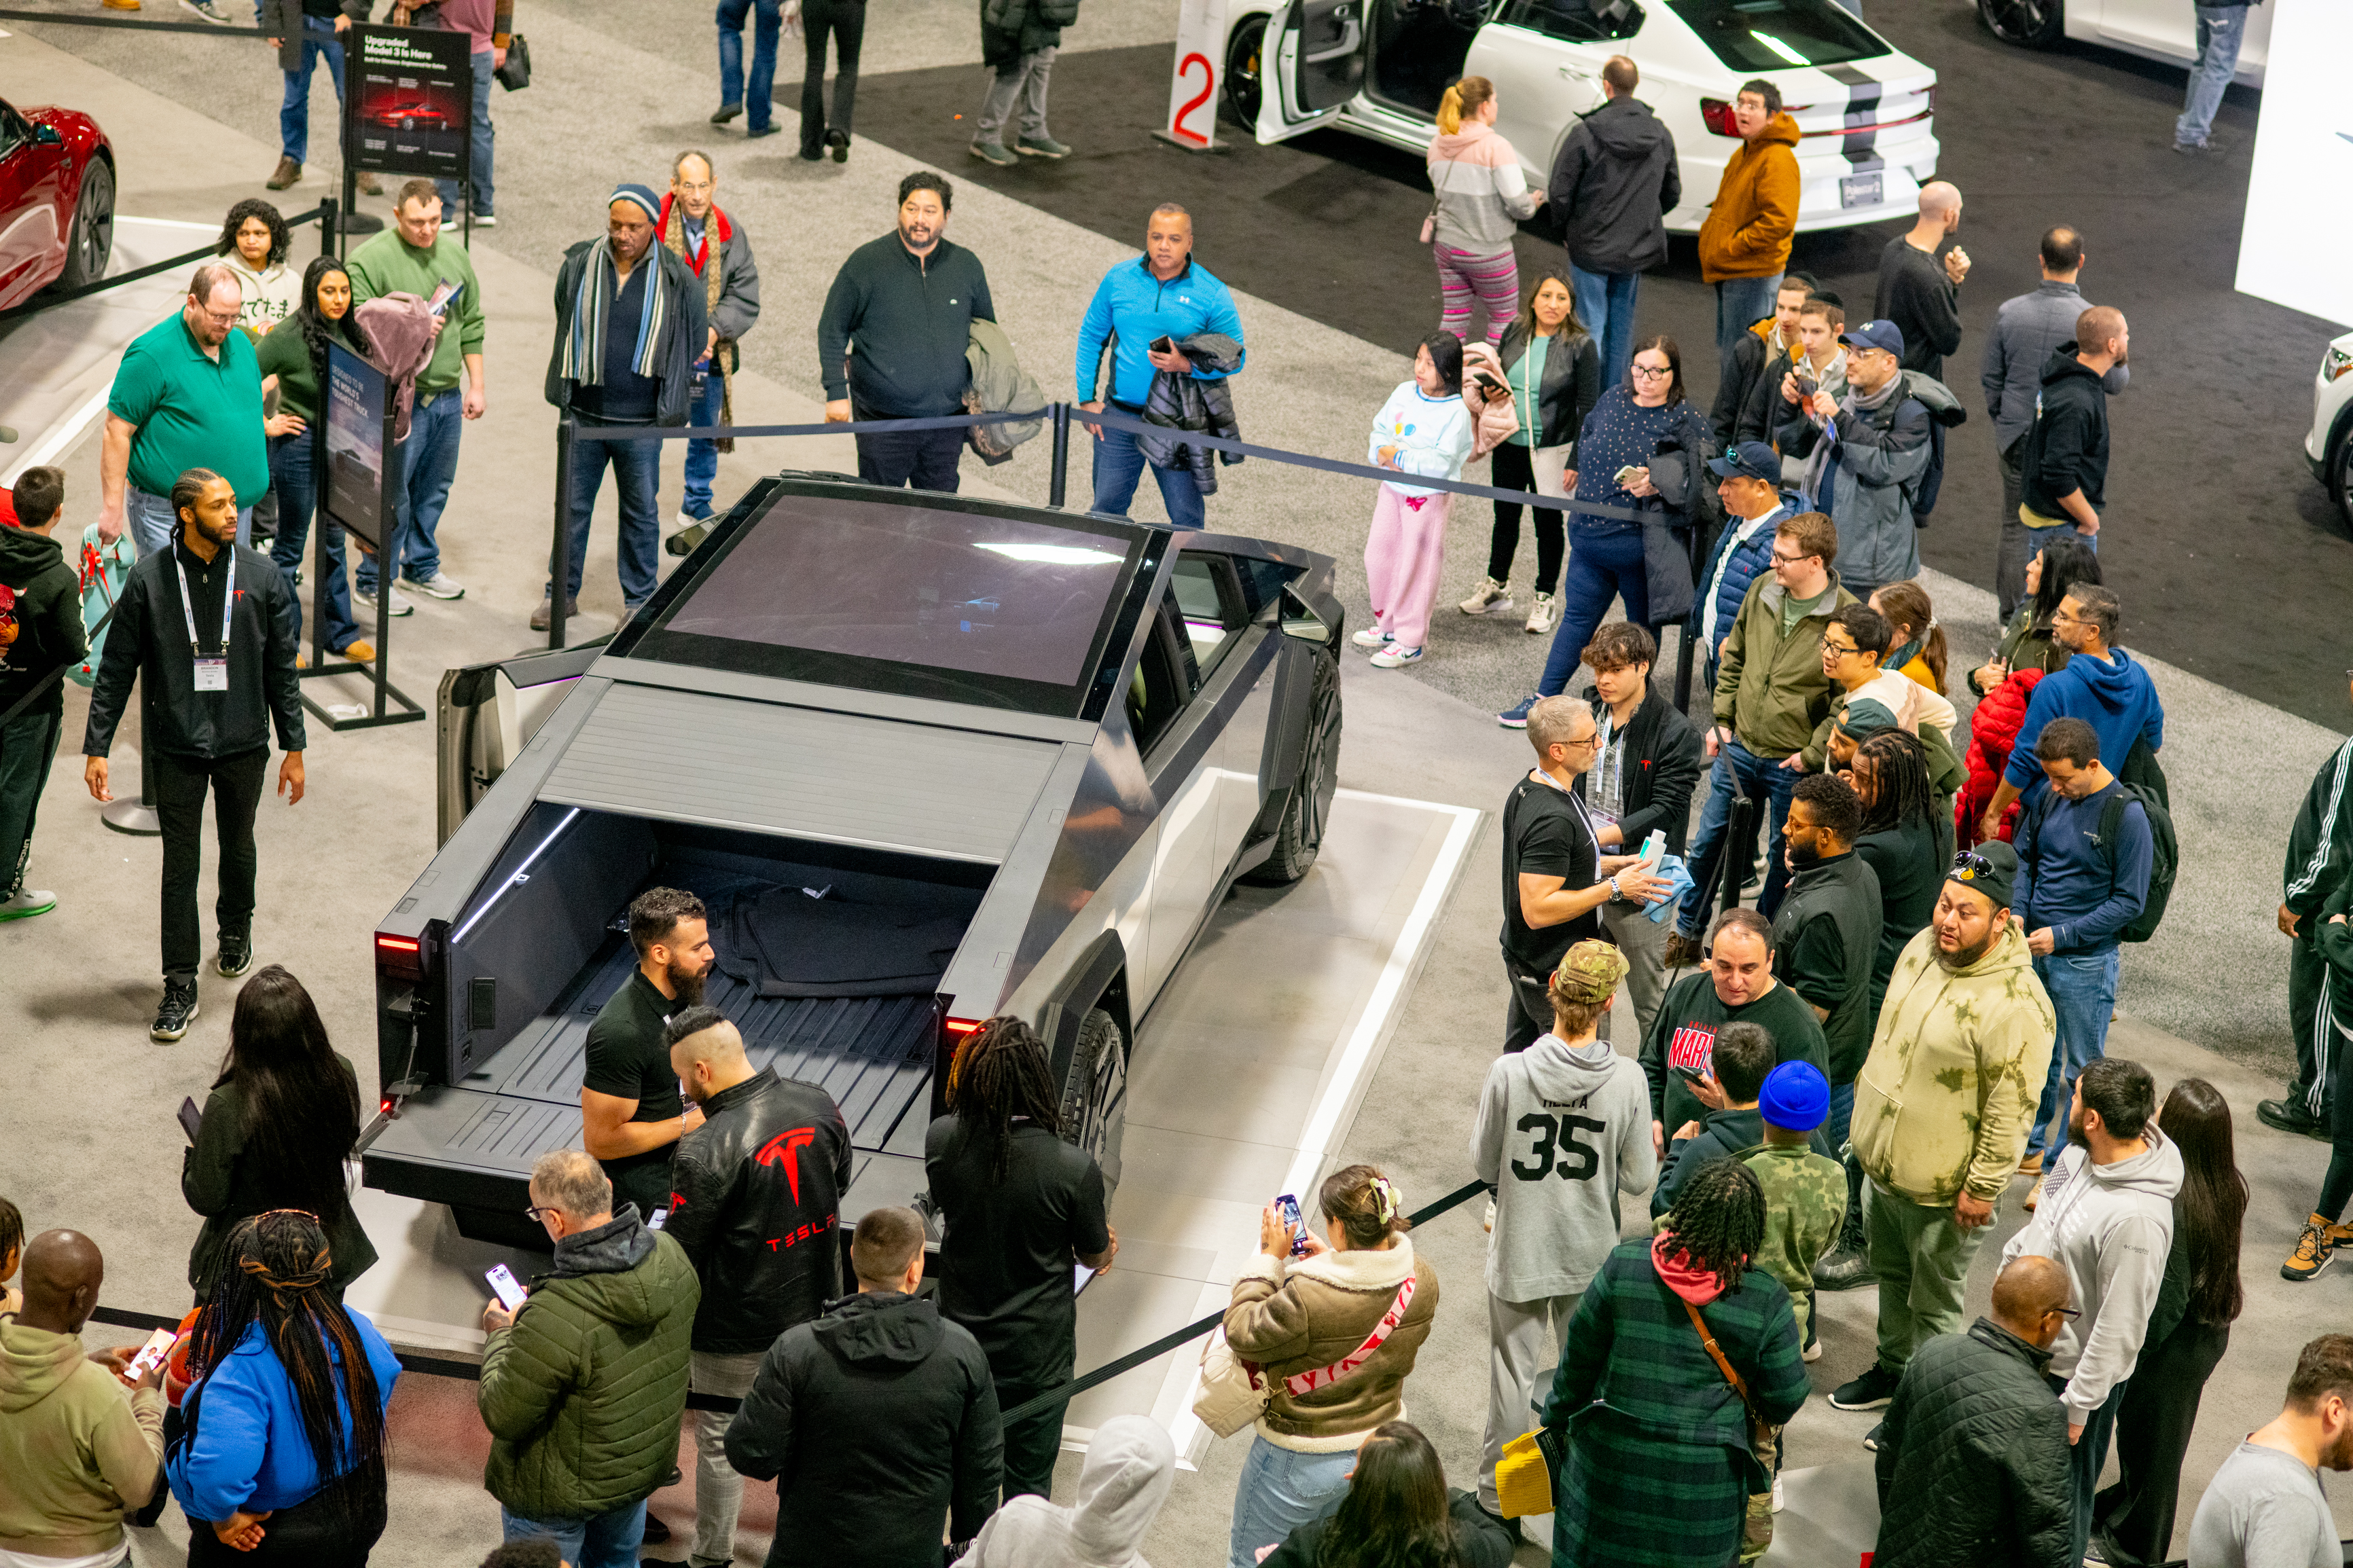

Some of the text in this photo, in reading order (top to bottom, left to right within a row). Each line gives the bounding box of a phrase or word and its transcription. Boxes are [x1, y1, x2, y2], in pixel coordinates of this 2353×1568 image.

[365, 35, 409, 48] Upgraded
[365, 44, 433, 60] Model 3 Is Here
[1173, 52, 1214, 145] 2
[1845, 181, 1880, 196] Polestar 2
[331, 376, 340, 388] THE
[331, 386, 353, 407] TOUGHEST
[1689, 1021, 1717, 1034] UNIVER
[1511, 1113, 1606, 1181] 35
[766, 1214, 836, 1252] TESLA
